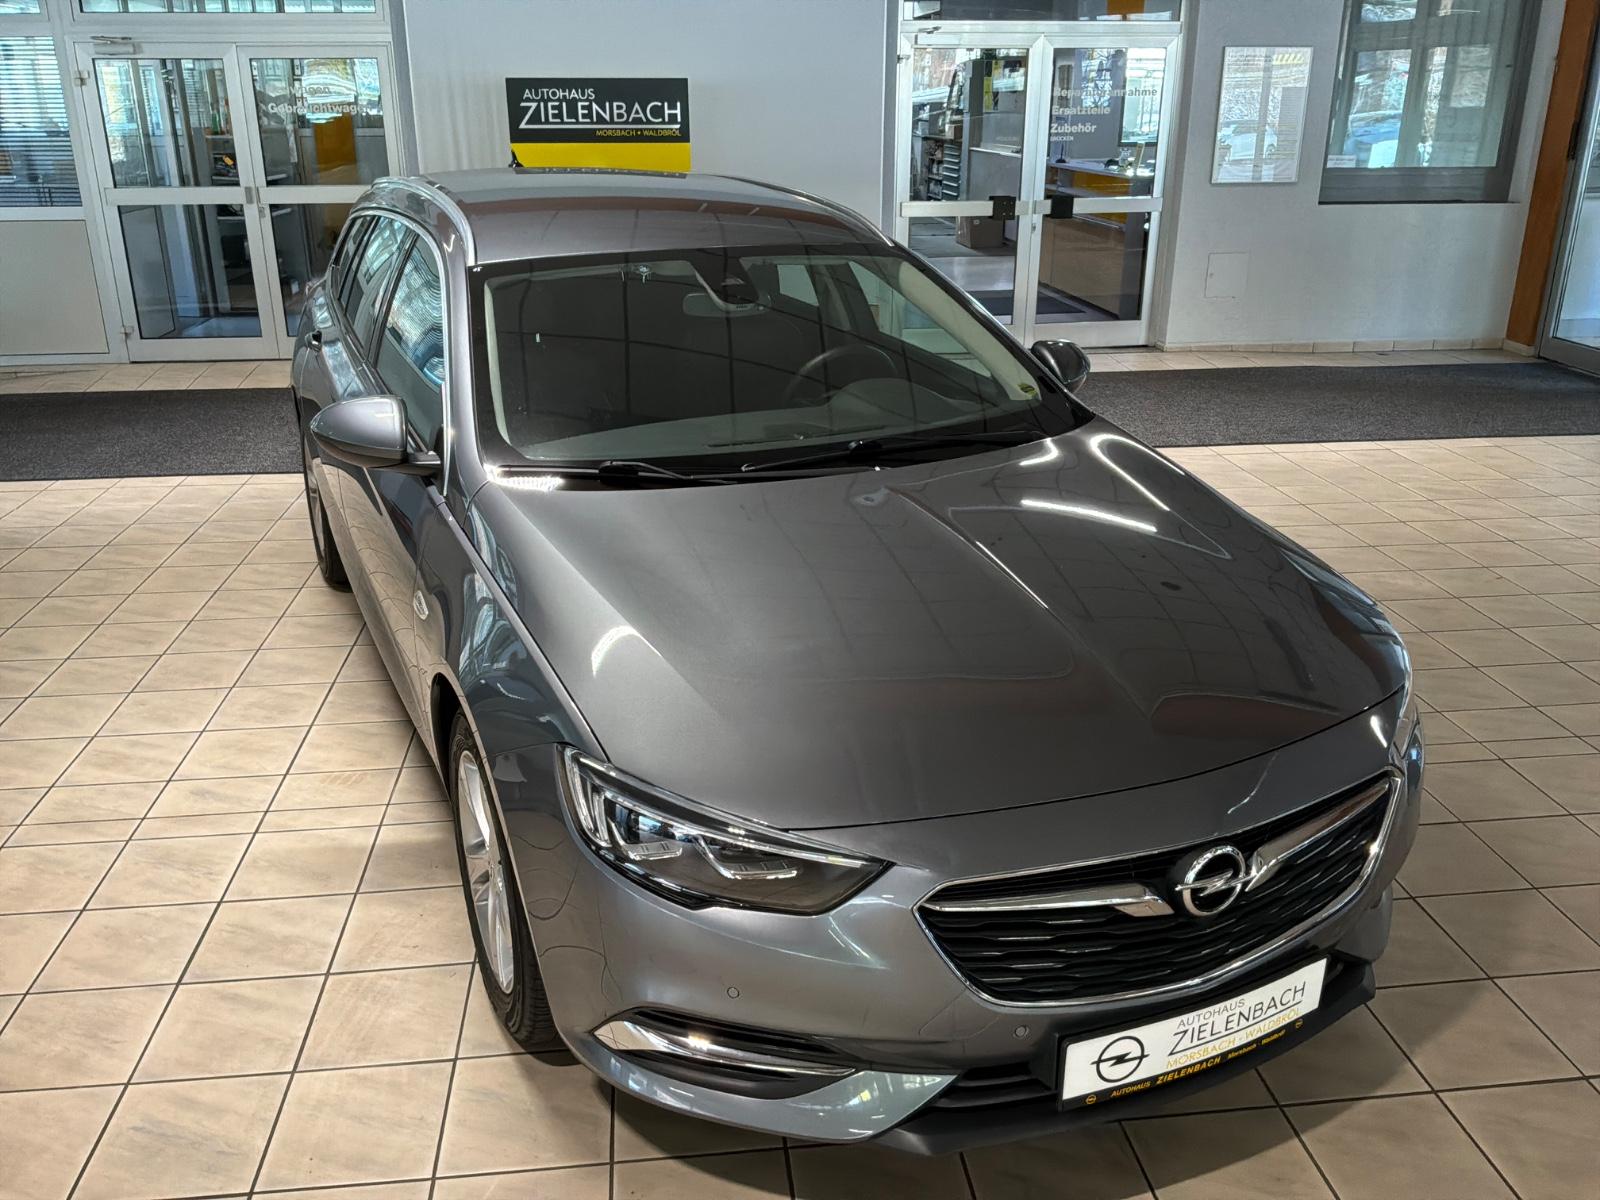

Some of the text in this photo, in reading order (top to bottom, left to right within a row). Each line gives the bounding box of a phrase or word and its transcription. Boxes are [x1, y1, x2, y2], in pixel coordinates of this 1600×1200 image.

[523, 88, 596, 100] AUTOHAUS
[518, 101, 682, 129] ZIELENBACH
[1051, 105, 1112, 115] Ersatzteile
[595, 129, 636, 137] MORSBACH
[1050, 122, 1097, 134] Zubehör
[1167, 981, 1306, 1057] ZIELENBACH
[1177, 998, 1246, 1029] AUTOHAUS
[1166, 1036, 1237, 1070] MORSBACH
[1110, 1081, 1152, 1098] AUTOHAUS
[1156, 1055, 1222, 1084] ZIELENBACH
